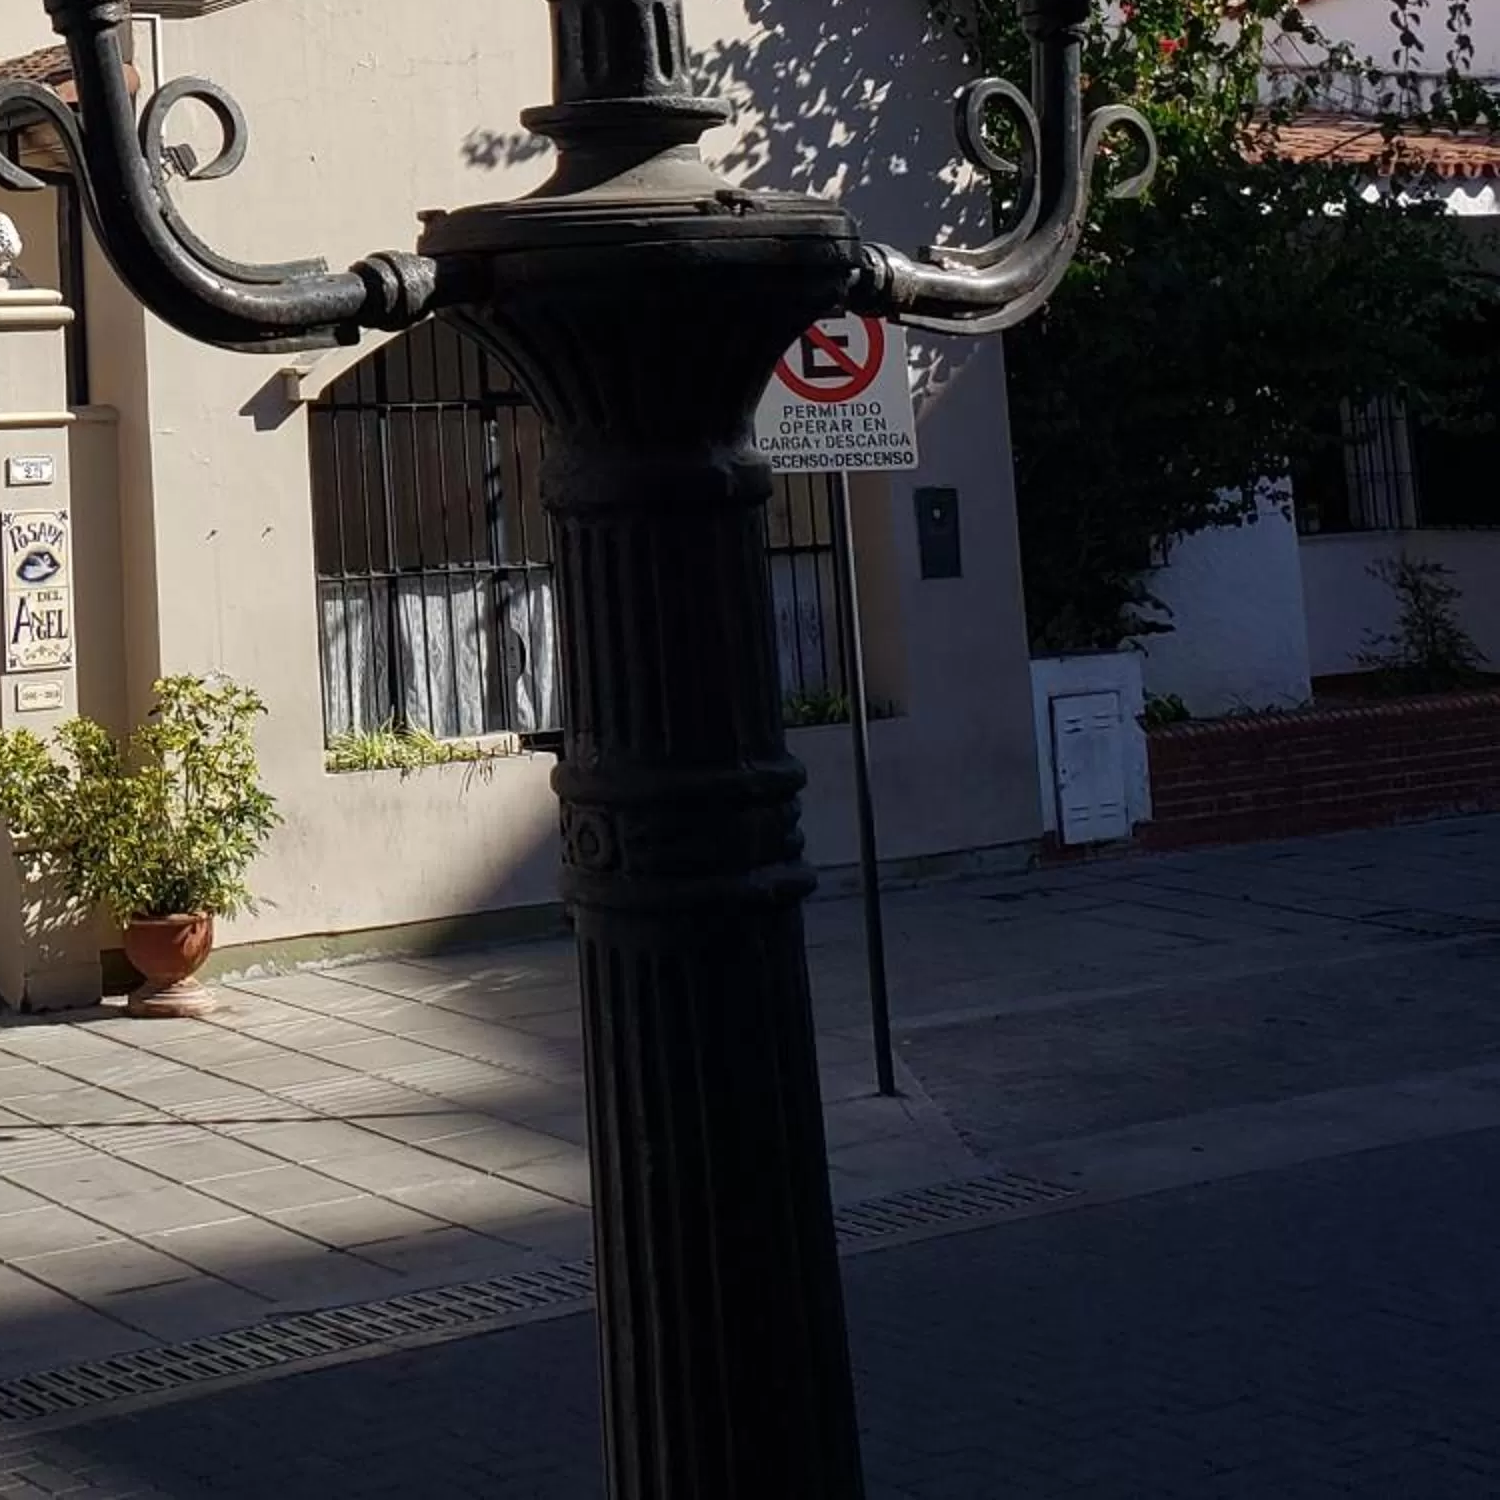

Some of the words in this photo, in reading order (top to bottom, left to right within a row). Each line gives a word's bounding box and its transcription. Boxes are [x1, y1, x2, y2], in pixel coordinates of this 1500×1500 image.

[783, 402, 882, 419] PERMITIDO
[779, 419, 853, 435] OPERAR
[863, 417, 887, 432] EN
[759, 436, 813, 451] CARGA
[825, 432, 911, 449] DESCARGA
[771, 453, 829, 469] SCENSO
[835, 451, 915, 467] DESCENSO
[9, 521, 63, 553] POSADA
[36, 589, 63, 603] DEL
